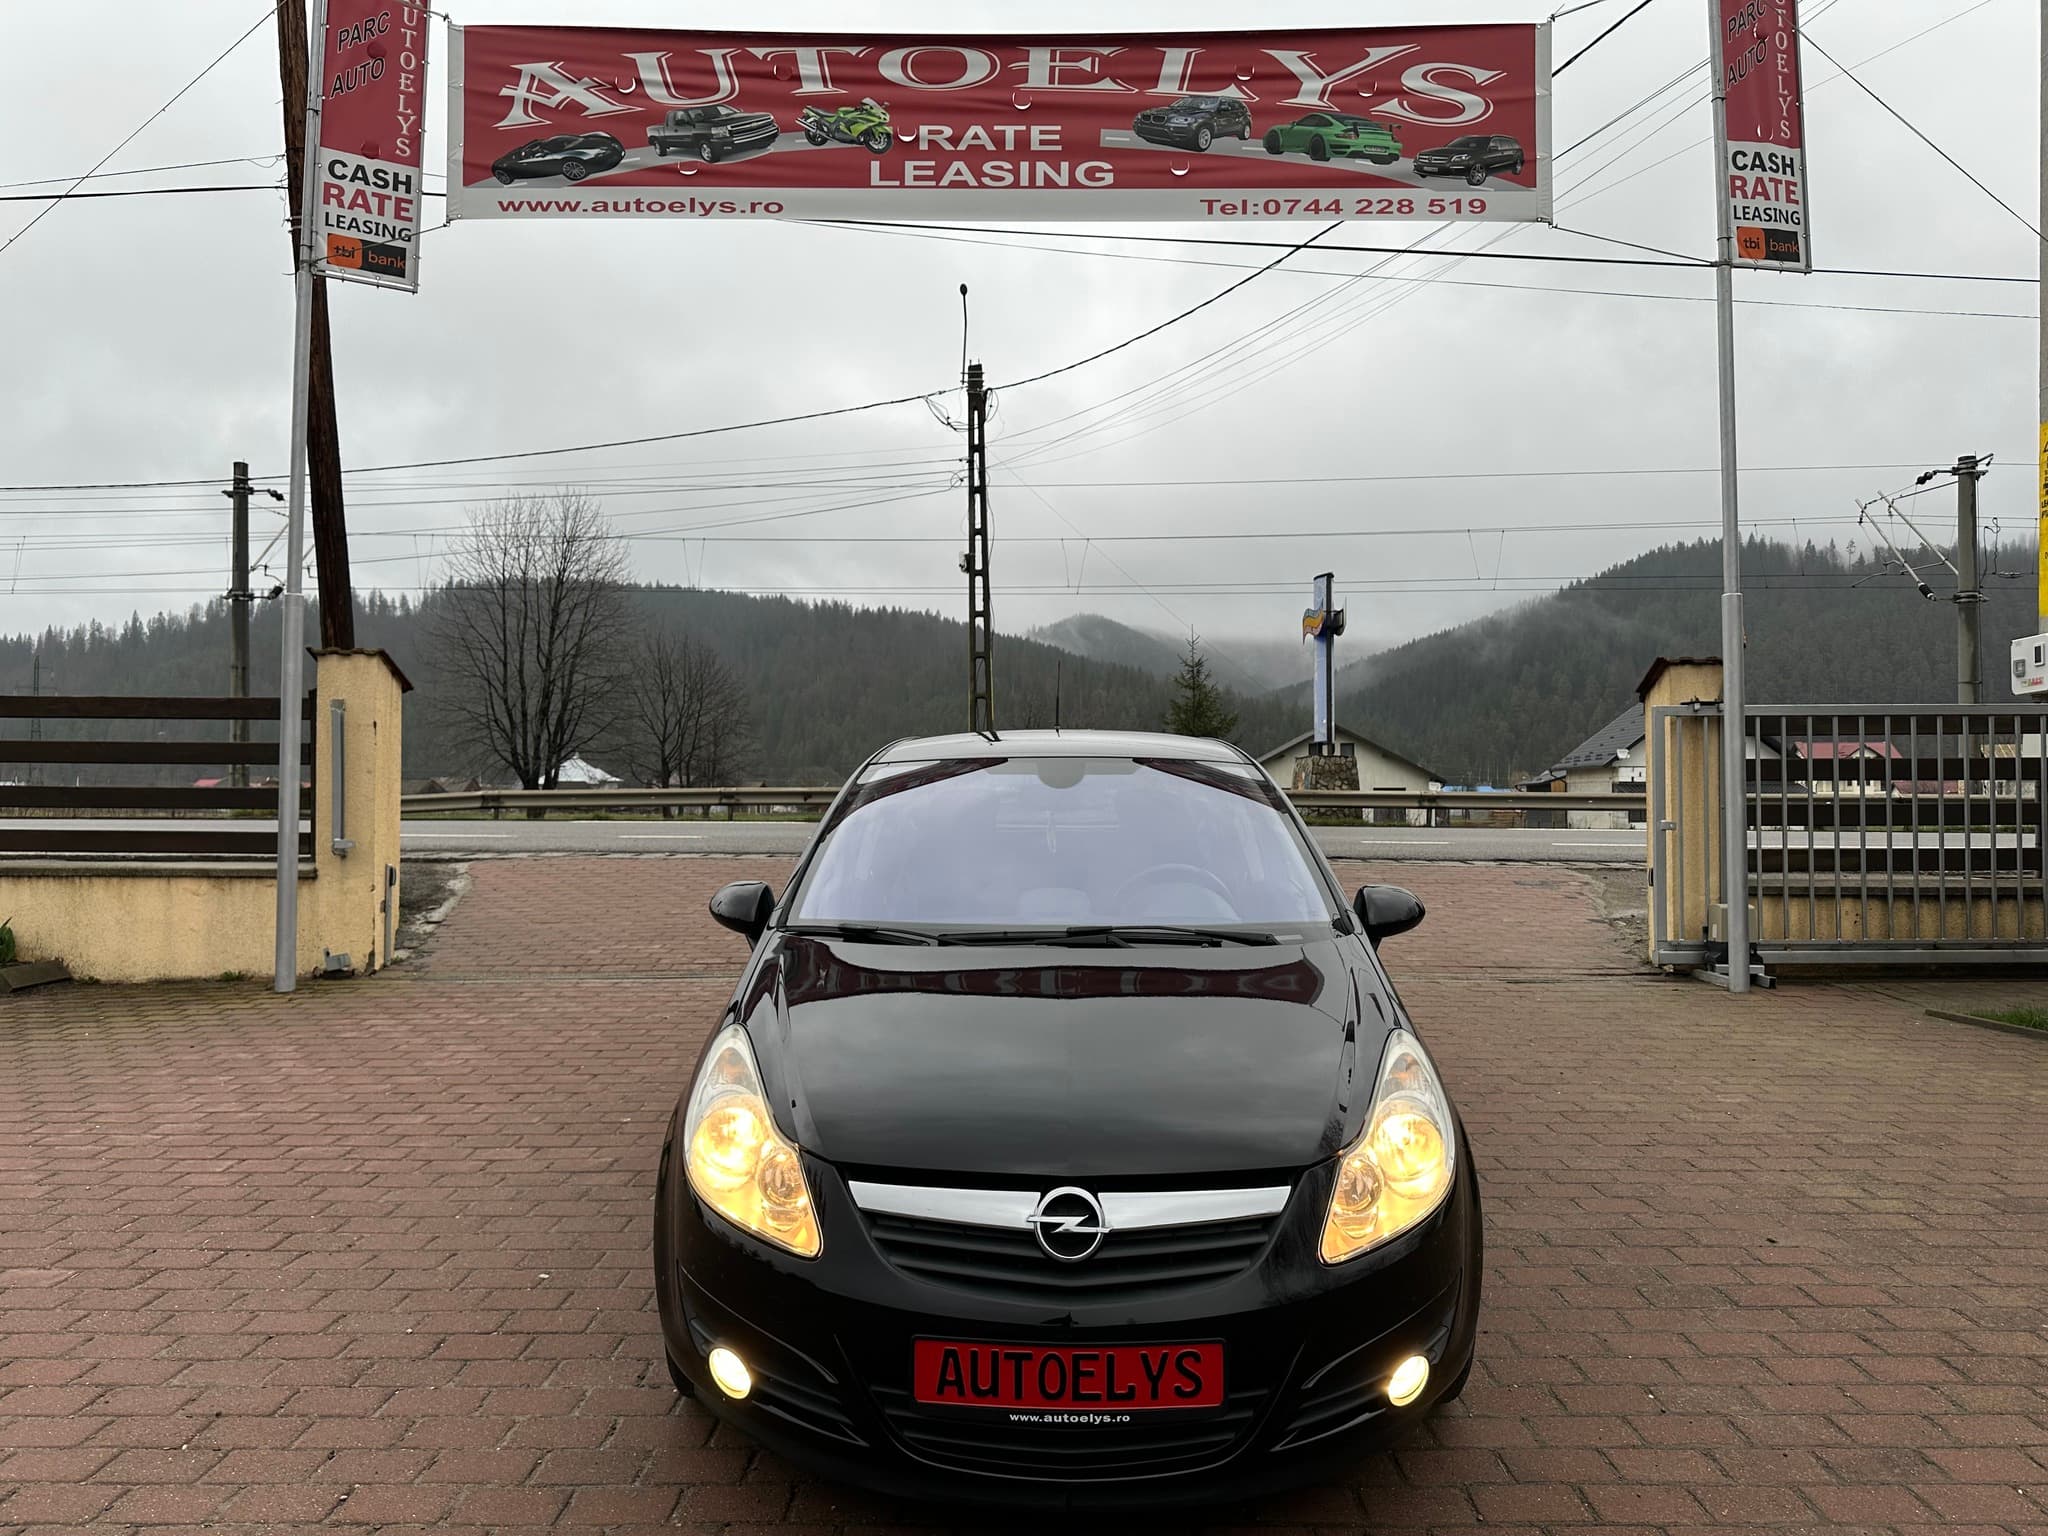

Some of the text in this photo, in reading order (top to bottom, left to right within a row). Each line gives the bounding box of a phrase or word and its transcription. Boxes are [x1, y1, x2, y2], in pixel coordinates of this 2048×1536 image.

[337, 11, 390, 53] PARC
[1727, 0, 1767, 43] PARC
[330, 57, 385, 98] AUTO
[1726, 38, 1767, 92] AUTO
[491, 43, 1508, 130] AUTOELYS
[919, 124, 1063, 151] RATE
[327, 159, 412, 194] CASH
[869, 159, 1115, 188] LEASING
[1731, 150, 1795, 177] CASH
[322, 181, 414, 223] RATE
[1729, 174, 1799, 206] RATE
[498, 197, 784, 217] www.autoelys.ro
[1200, 198, 1487, 216] Tel:0744 228 519
[1733, 205, 1800, 226] LEASING
[324, 211, 412, 243] LEASING
[333, 244, 406, 269] tbi bank
[1743, 236, 1799, 253] tbi bank
[936, 1347, 1203, 1402] AUTOELYS
[1009, 1411, 1131, 1424] www.autoelys.ro
